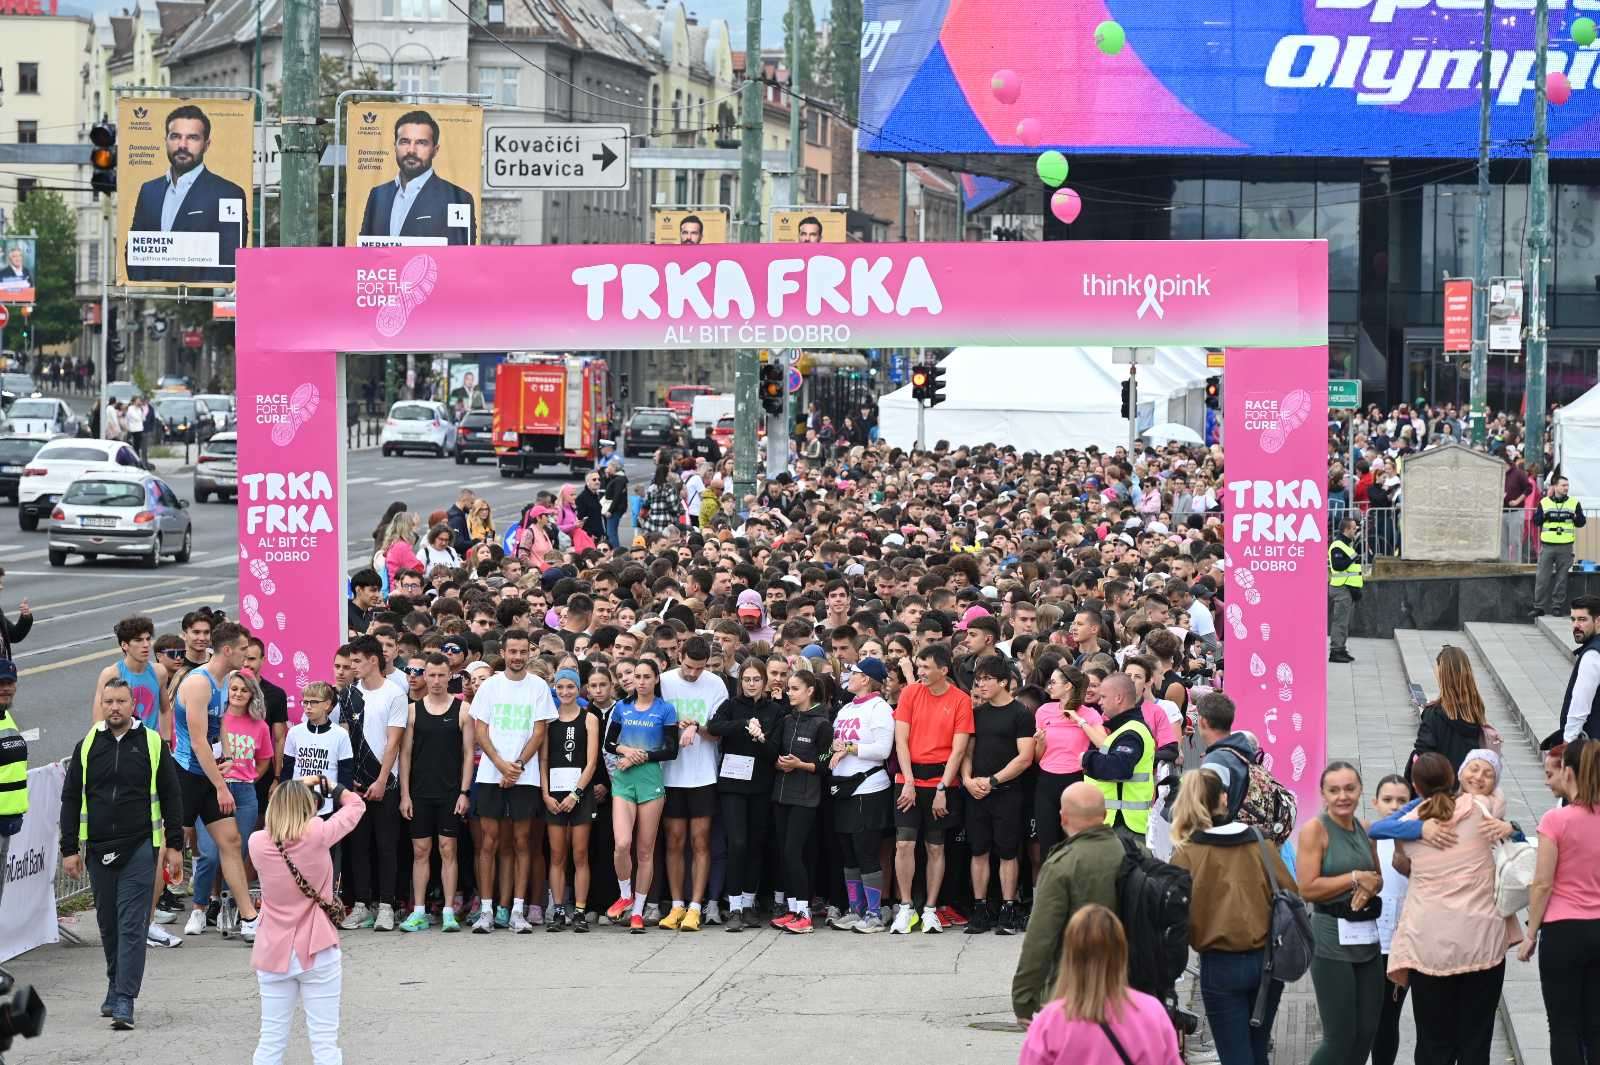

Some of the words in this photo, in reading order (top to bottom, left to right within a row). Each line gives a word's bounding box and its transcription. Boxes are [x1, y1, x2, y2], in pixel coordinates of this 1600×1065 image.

[1265, 35, 1600, 105] Olympi
[495, 135, 580, 153] Kovačići
[494, 159, 584, 176] Grbavica
[226, 205, 236, 215] 1.
[454, 210, 464, 220] 1.
[132, 237, 174, 245] NERMIN
[132, 246, 168, 254] MUZUR
[356, 269, 397, 281] RACE
[356, 282, 384, 295] FOR
[387, 282, 413, 294] THE
[571, 261, 755, 321] TRKA
[766, 255, 943, 317] FRKA
[1083, 272, 1141, 296] think
[1159, 272, 1211, 303] pink
[356, 295, 397, 308] CURE
[664, 325, 693, 343] AL'
[700, 325, 733, 343] BIT
[738, 320, 767, 343] ĆE
[773, 324, 851, 343] DOBRO
[256, 394, 288, 404] RACE
[1244, 400, 1278, 410] RACE
[256, 404, 278, 414] FOR
[280, 404, 300, 414] THE
[1244, 410, 1268, 420] FOR
[1270, 410, 1291, 420] THE
[256, 414, 288, 424] CURE
[1244, 420, 1278, 431] CURE
[241, 470, 333, 501] TRKA
[1228, 479, 1322, 509] TRKA
[246, 504, 334, 534] FRKA
[1232, 512, 1321, 543] FRKA
[278, 536, 298, 548] BIT
[265, 551, 310, 562] DOBRO
[1265, 546, 1285, 557] BIT
[1287, 544, 1305, 557] ĆE
[1250, 560, 1297, 572] DOBRO
[624, 719, 657, 727] ROMANIA
[1, 740, 25, 749] SECURITY
[298, 747, 329, 760] SASVIM
[5, 851, 28, 883] niCredit
